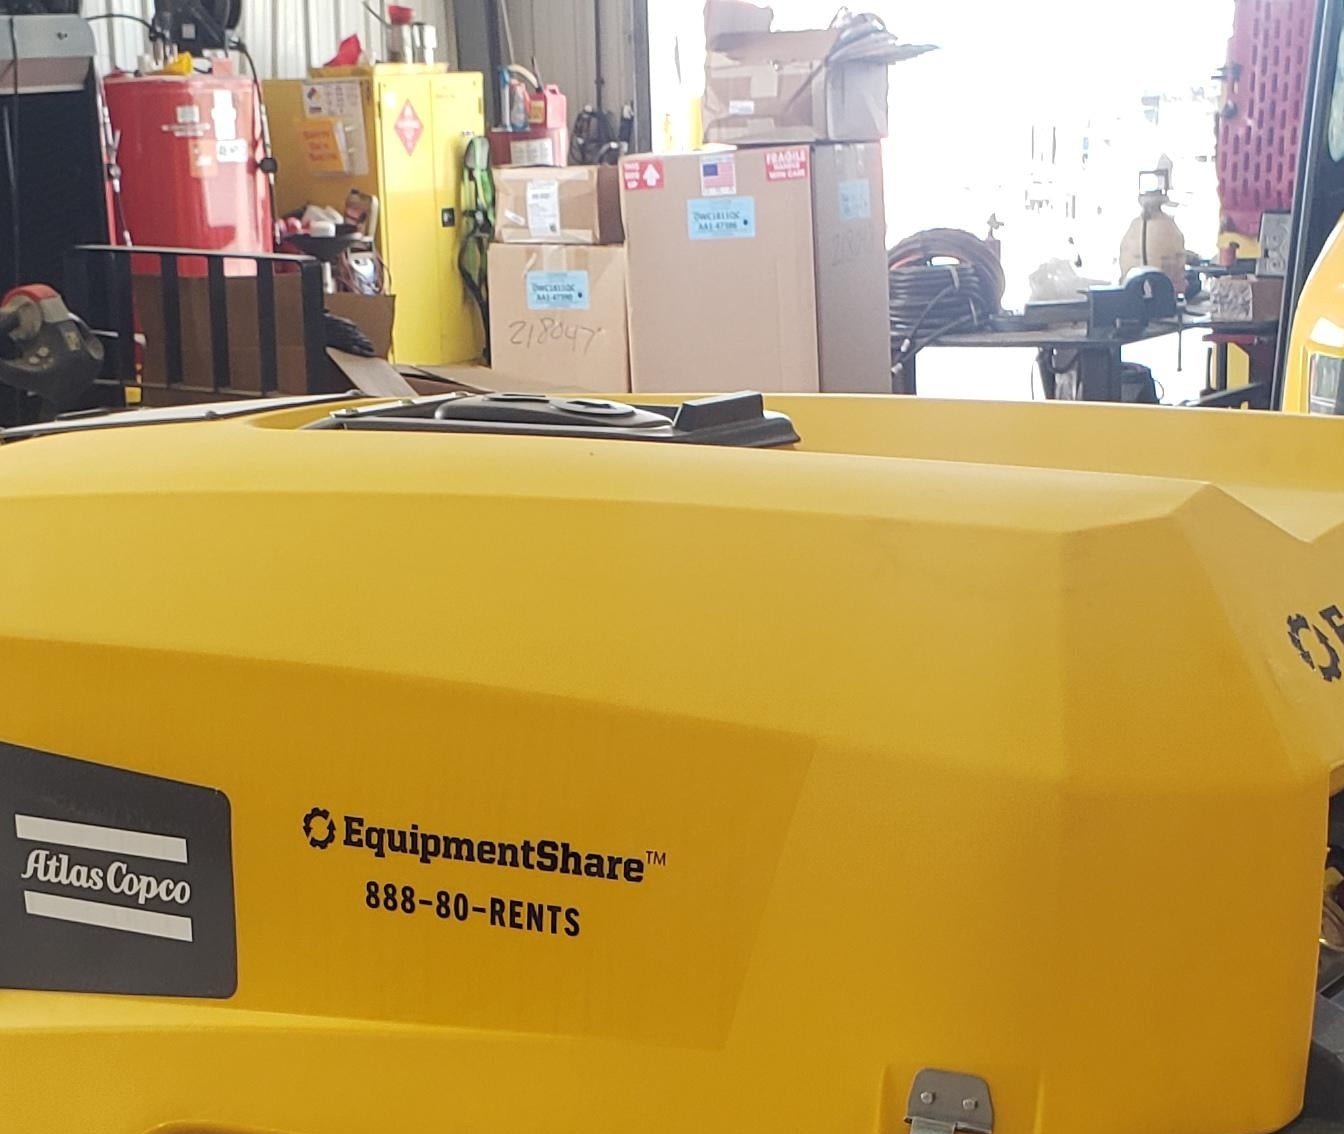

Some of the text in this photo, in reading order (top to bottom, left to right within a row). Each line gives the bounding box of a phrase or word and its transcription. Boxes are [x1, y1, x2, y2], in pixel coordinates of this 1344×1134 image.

[766, 150, 806, 165] FRAGILE
[21, 849, 191, 905] Atlas Copco
[343, 815, 645, 883] EquipmentShare
[365, 881, 580, 937] 888-80-RENTS
